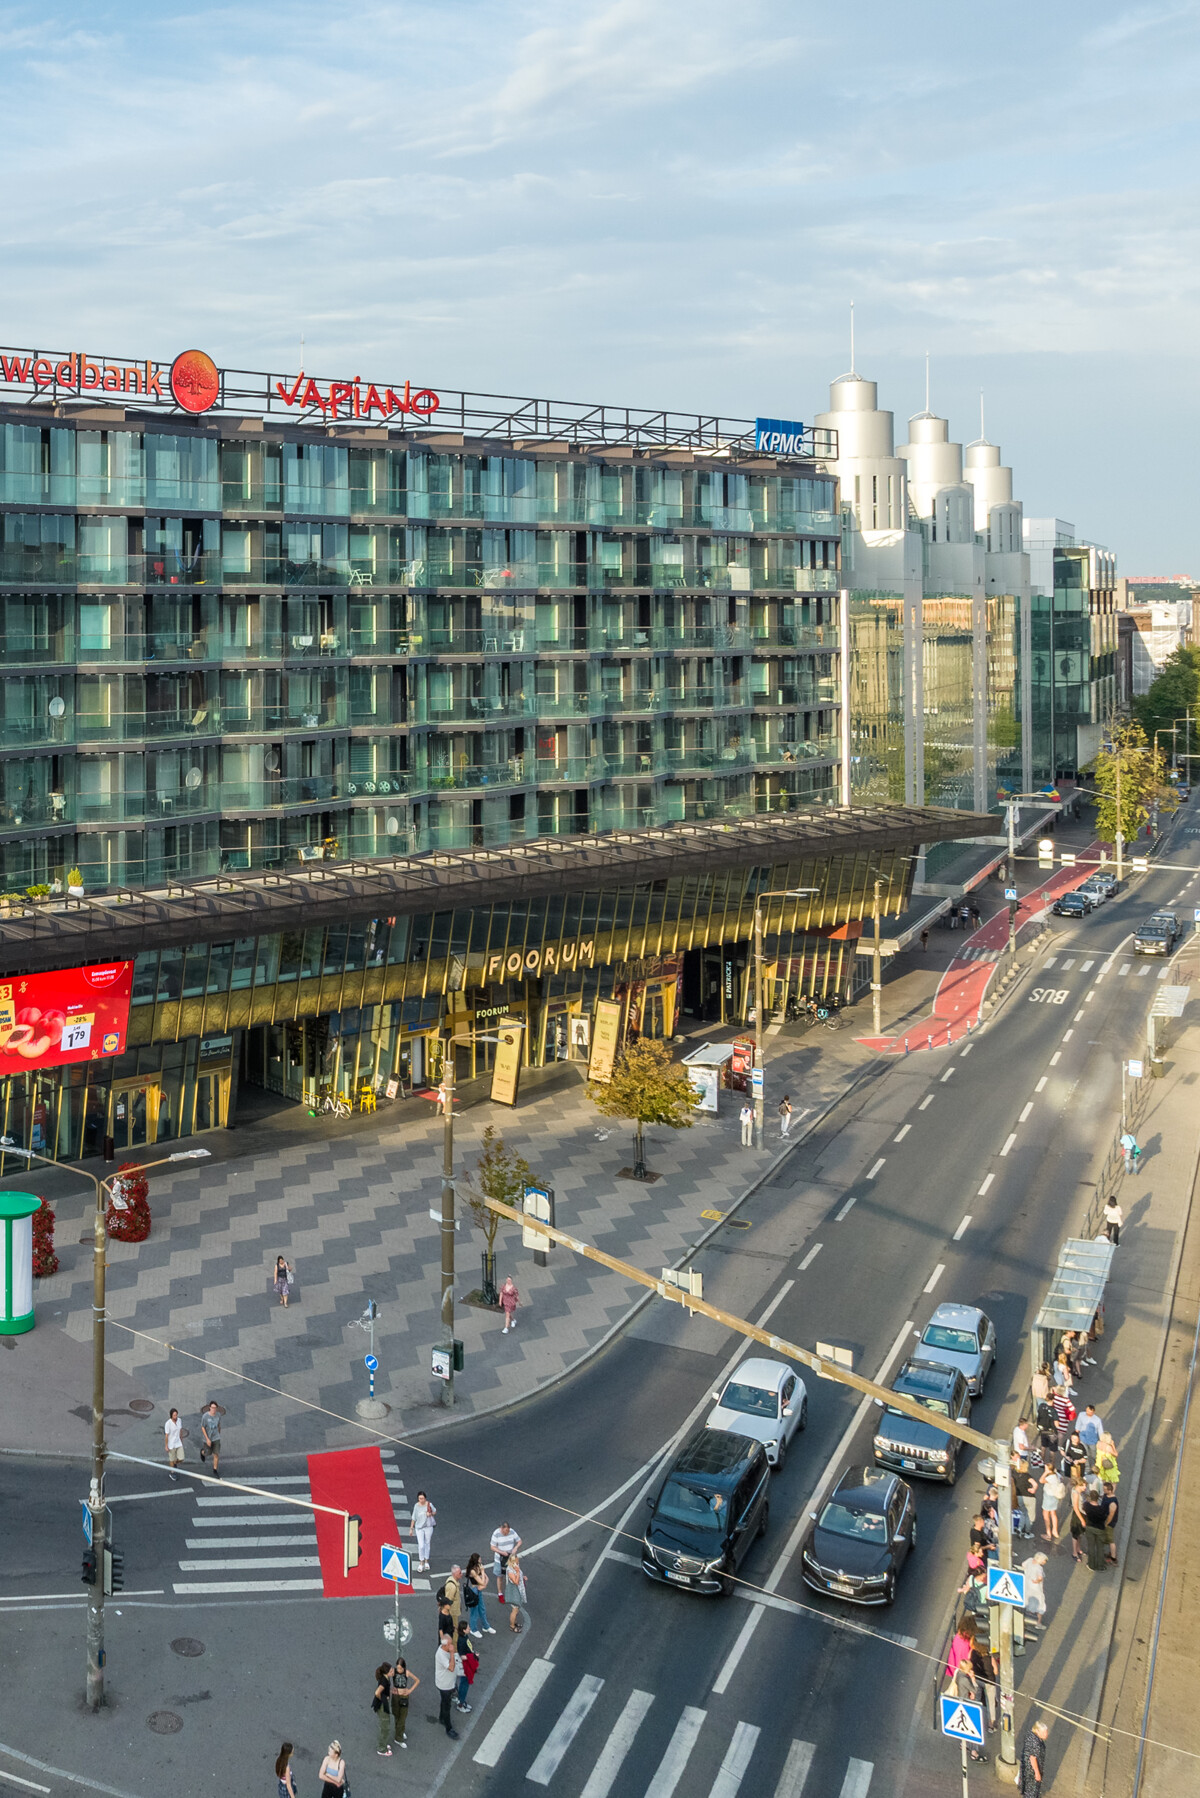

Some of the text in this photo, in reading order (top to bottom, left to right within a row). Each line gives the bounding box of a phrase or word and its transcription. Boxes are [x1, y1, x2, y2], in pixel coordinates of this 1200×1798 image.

[758, 431, 804, 454] KPMG
[488, 941, 593, 976] FOORUM
[3, 986, 10, 999] 3
[1028, 988, 1070, 1005] BUS
[476, 1005, 509, 1019] FOORUM
